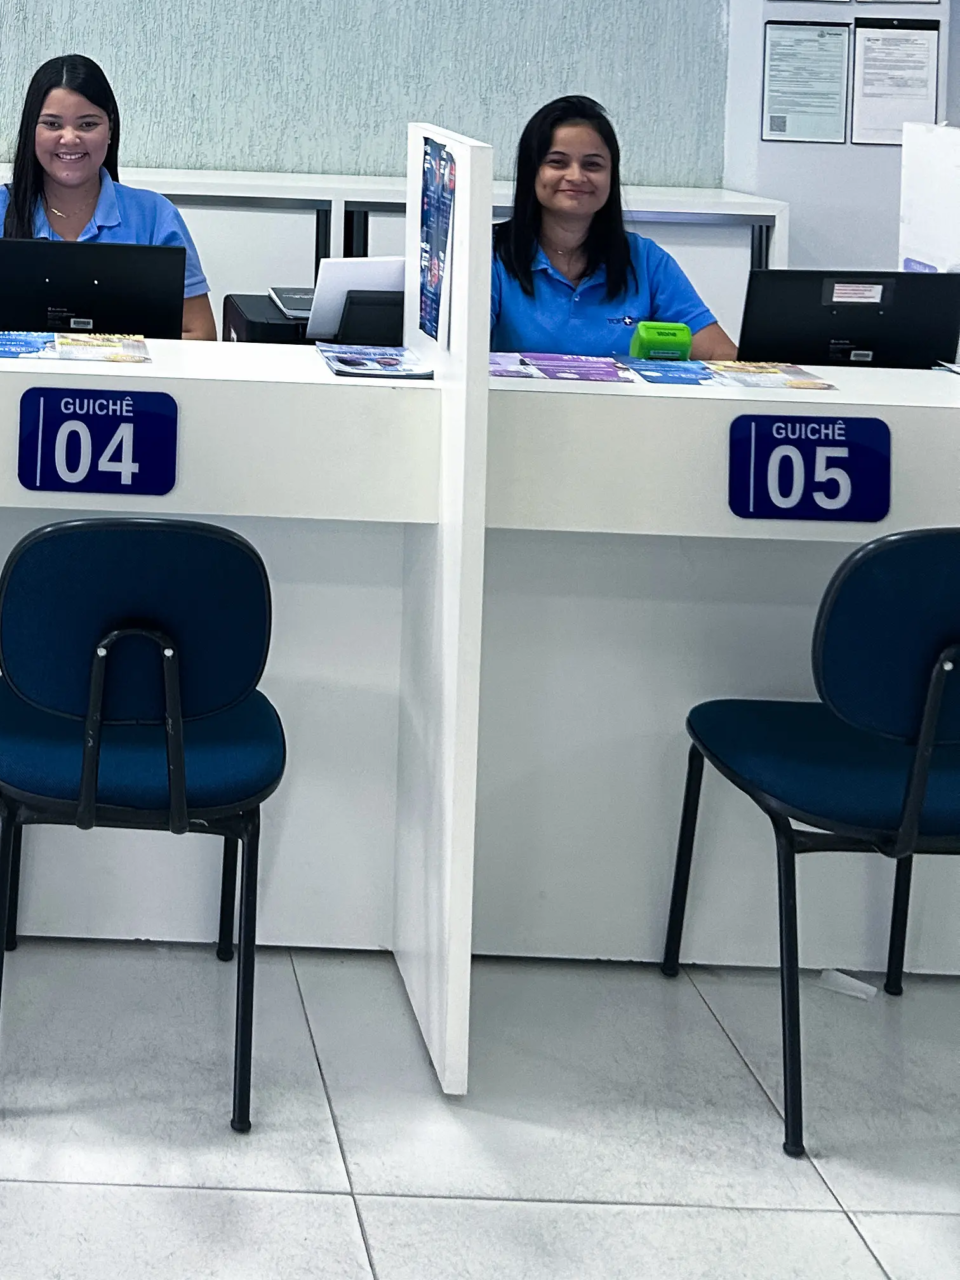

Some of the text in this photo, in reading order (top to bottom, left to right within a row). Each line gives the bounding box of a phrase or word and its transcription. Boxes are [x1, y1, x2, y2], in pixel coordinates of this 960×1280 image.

[60, 396, 134, 417] GUICHÊ
[772, 420, 846, 440] GUICHÊ
[54, 419, 140, 485] 04
[767, 444, 852, 510] 05
